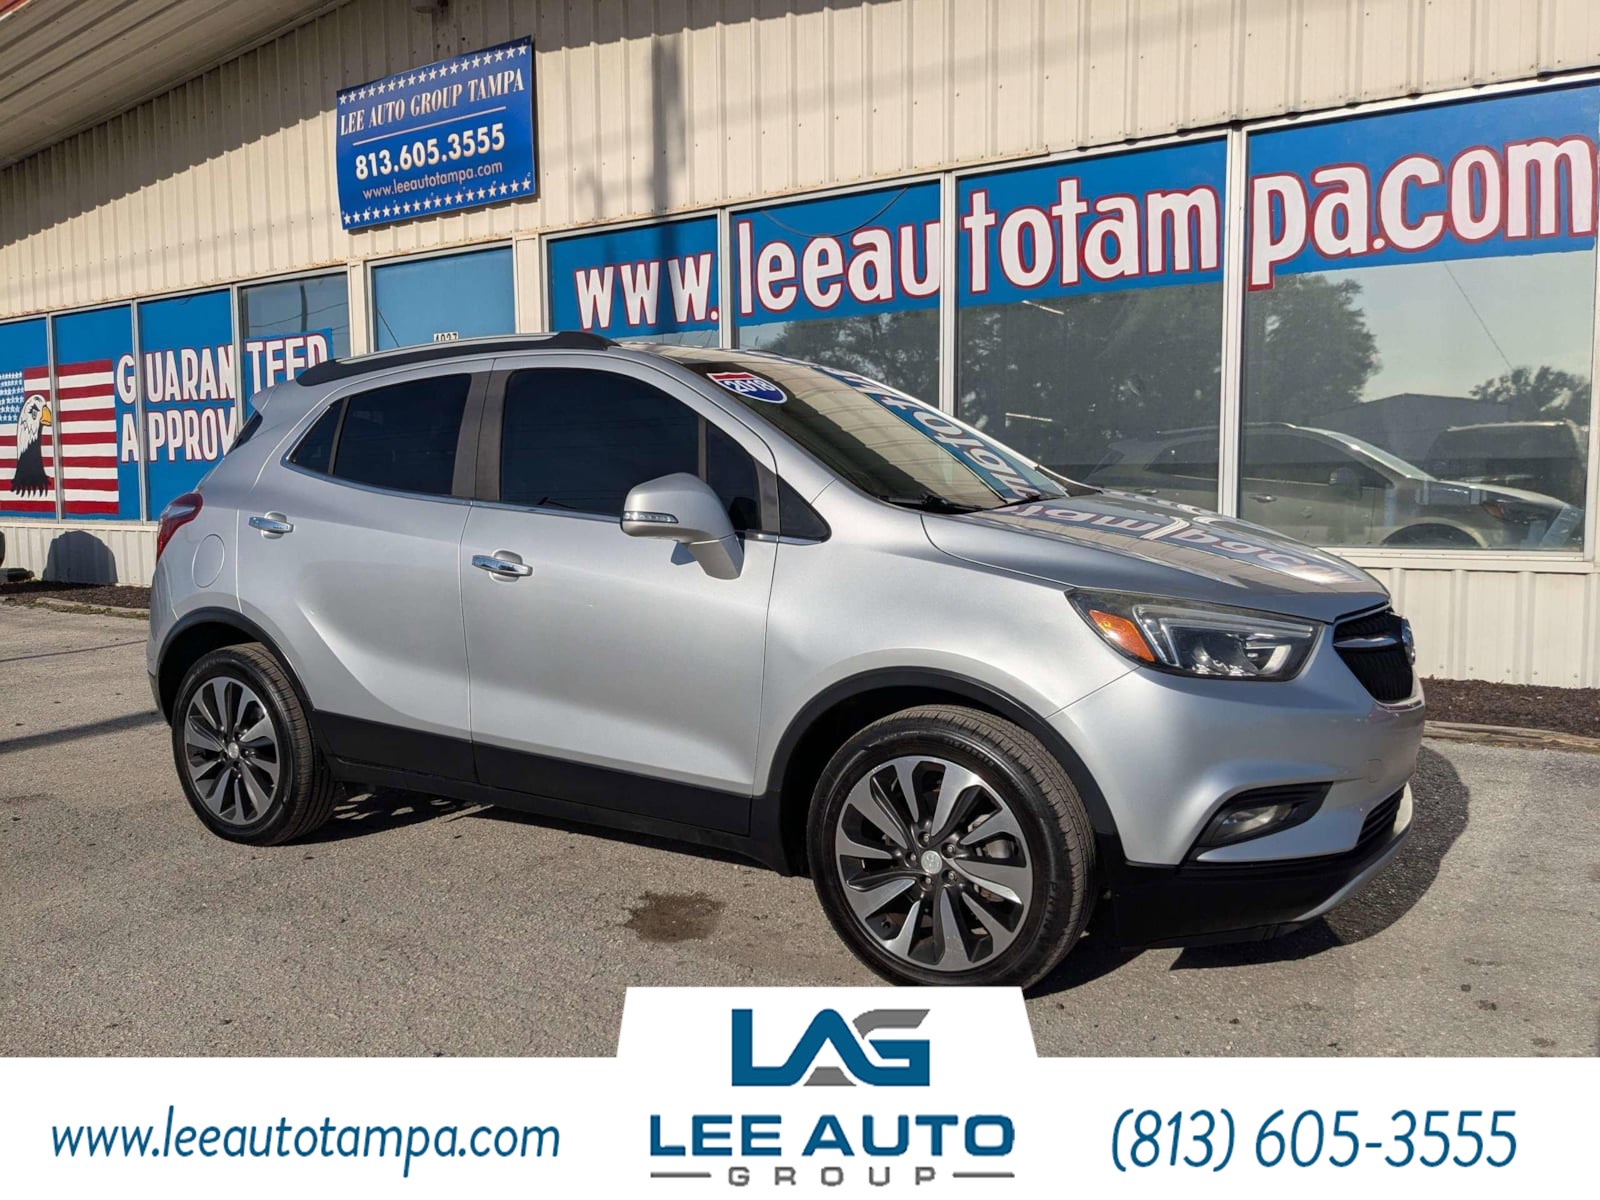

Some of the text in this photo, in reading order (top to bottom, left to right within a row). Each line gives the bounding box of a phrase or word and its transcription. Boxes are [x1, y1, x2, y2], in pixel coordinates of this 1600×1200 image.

[340, 68, 524, 136] LEE AUTO GROUP TAMPA
[355, 123, 506, 180] 813.605.3555
[362, 161, 503, 200] www.leeautotampa.com
